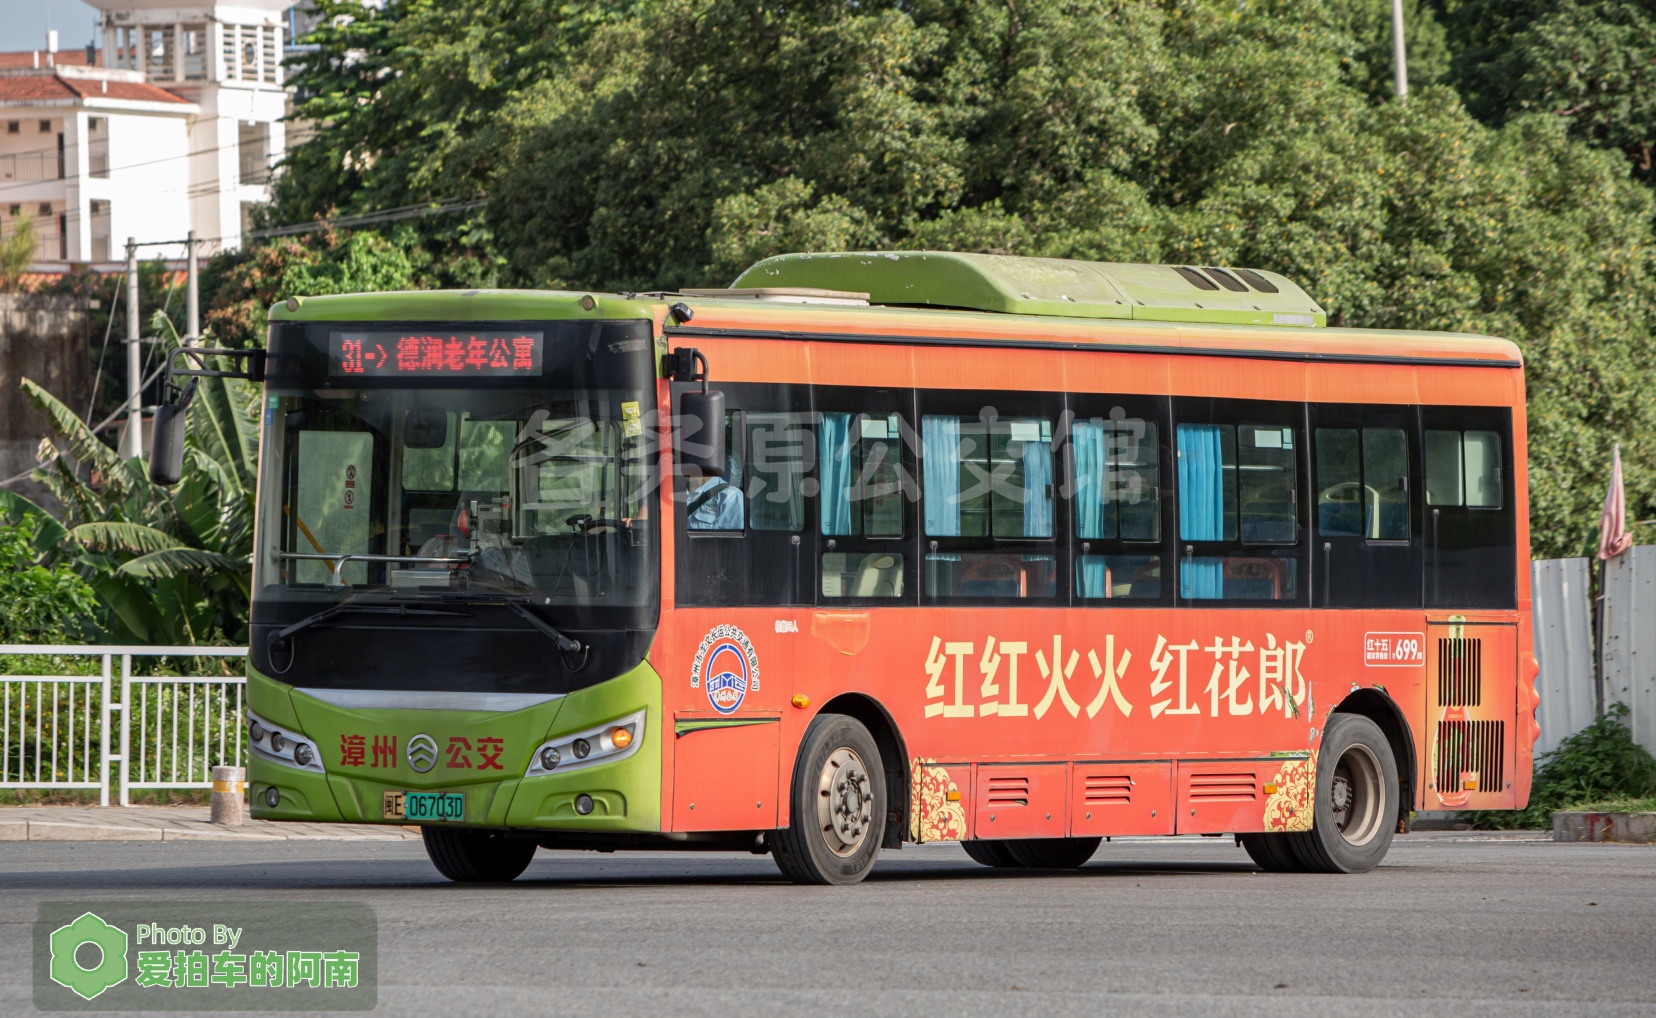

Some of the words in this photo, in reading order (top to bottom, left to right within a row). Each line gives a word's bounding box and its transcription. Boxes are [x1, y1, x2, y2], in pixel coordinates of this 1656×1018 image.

[1366, 639, 1388, 651] 红十五
[924, 634, 1133, 720] 红红火火
[339, 734, 397, 768] 漳州
[445, 736, 504, 770] 公交
